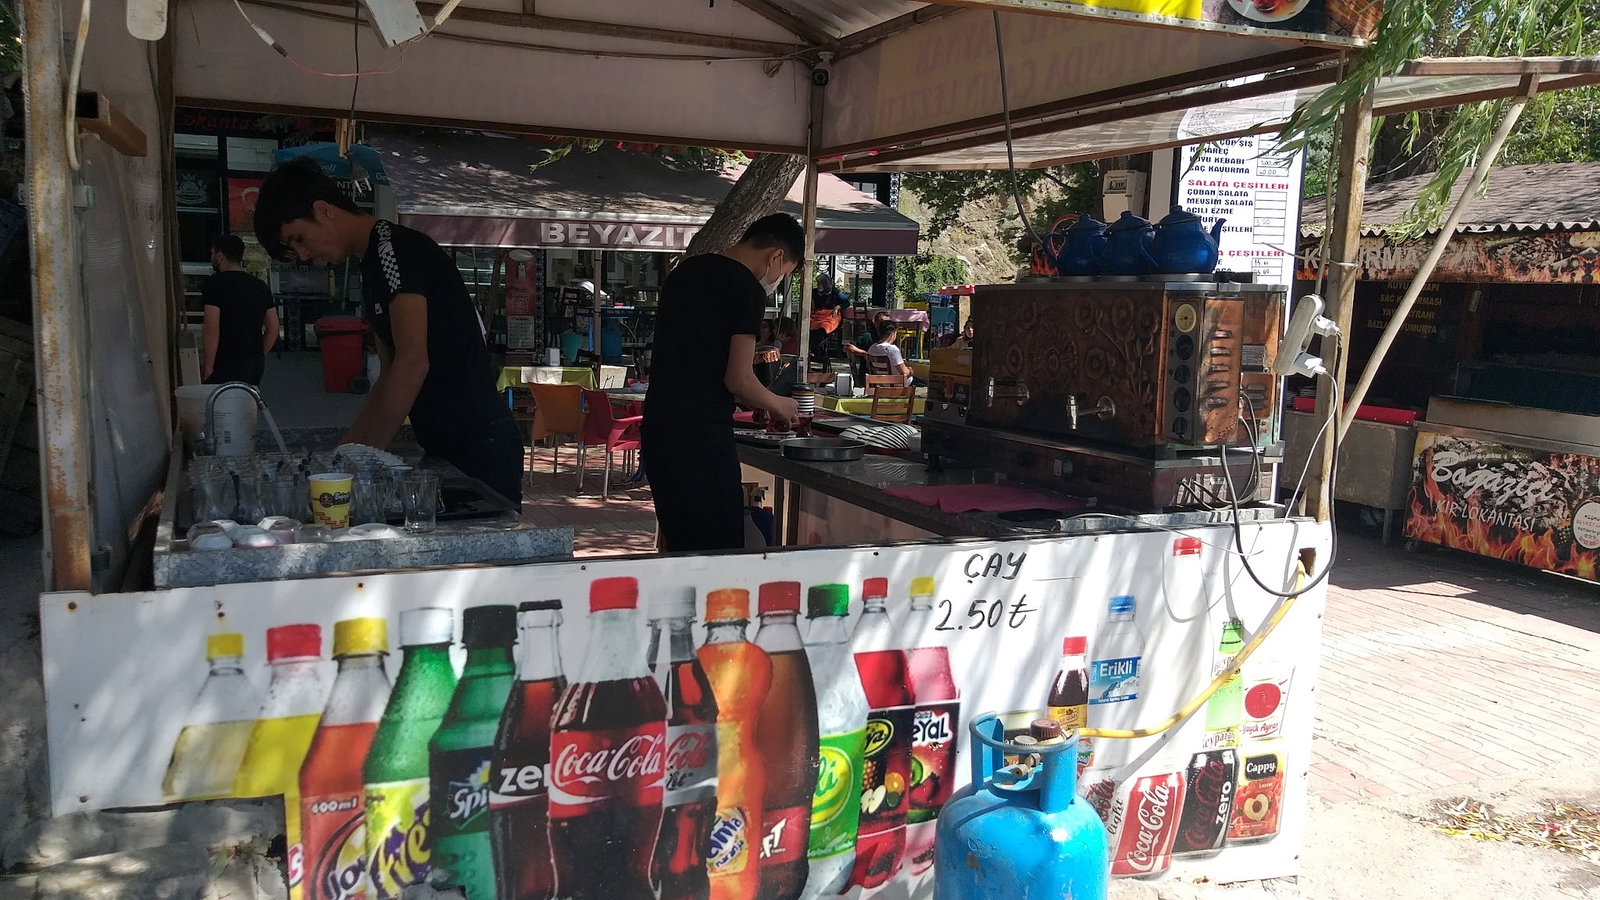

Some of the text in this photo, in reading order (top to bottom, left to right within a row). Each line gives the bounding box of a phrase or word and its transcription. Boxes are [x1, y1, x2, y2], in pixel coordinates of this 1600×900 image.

[1187, 179, 1229, 188] SALATA
[1187, 188, 1249, 198] ÇOBAN SALATA
[1224, 199, 1254, 207] SALATA
[1211, 207, 1234, 215] EZME
[540, 222, 699, 247] BEYAZIT
[1461, 502, 1536, 532] LOKANTASI
[964, 552, 1027, 583] ÇAY
[1100, 660, 1133, 677] Erikli
[1246, 762, 1276, 774] Cappy
[1215, 781, 1232, 825] zero
